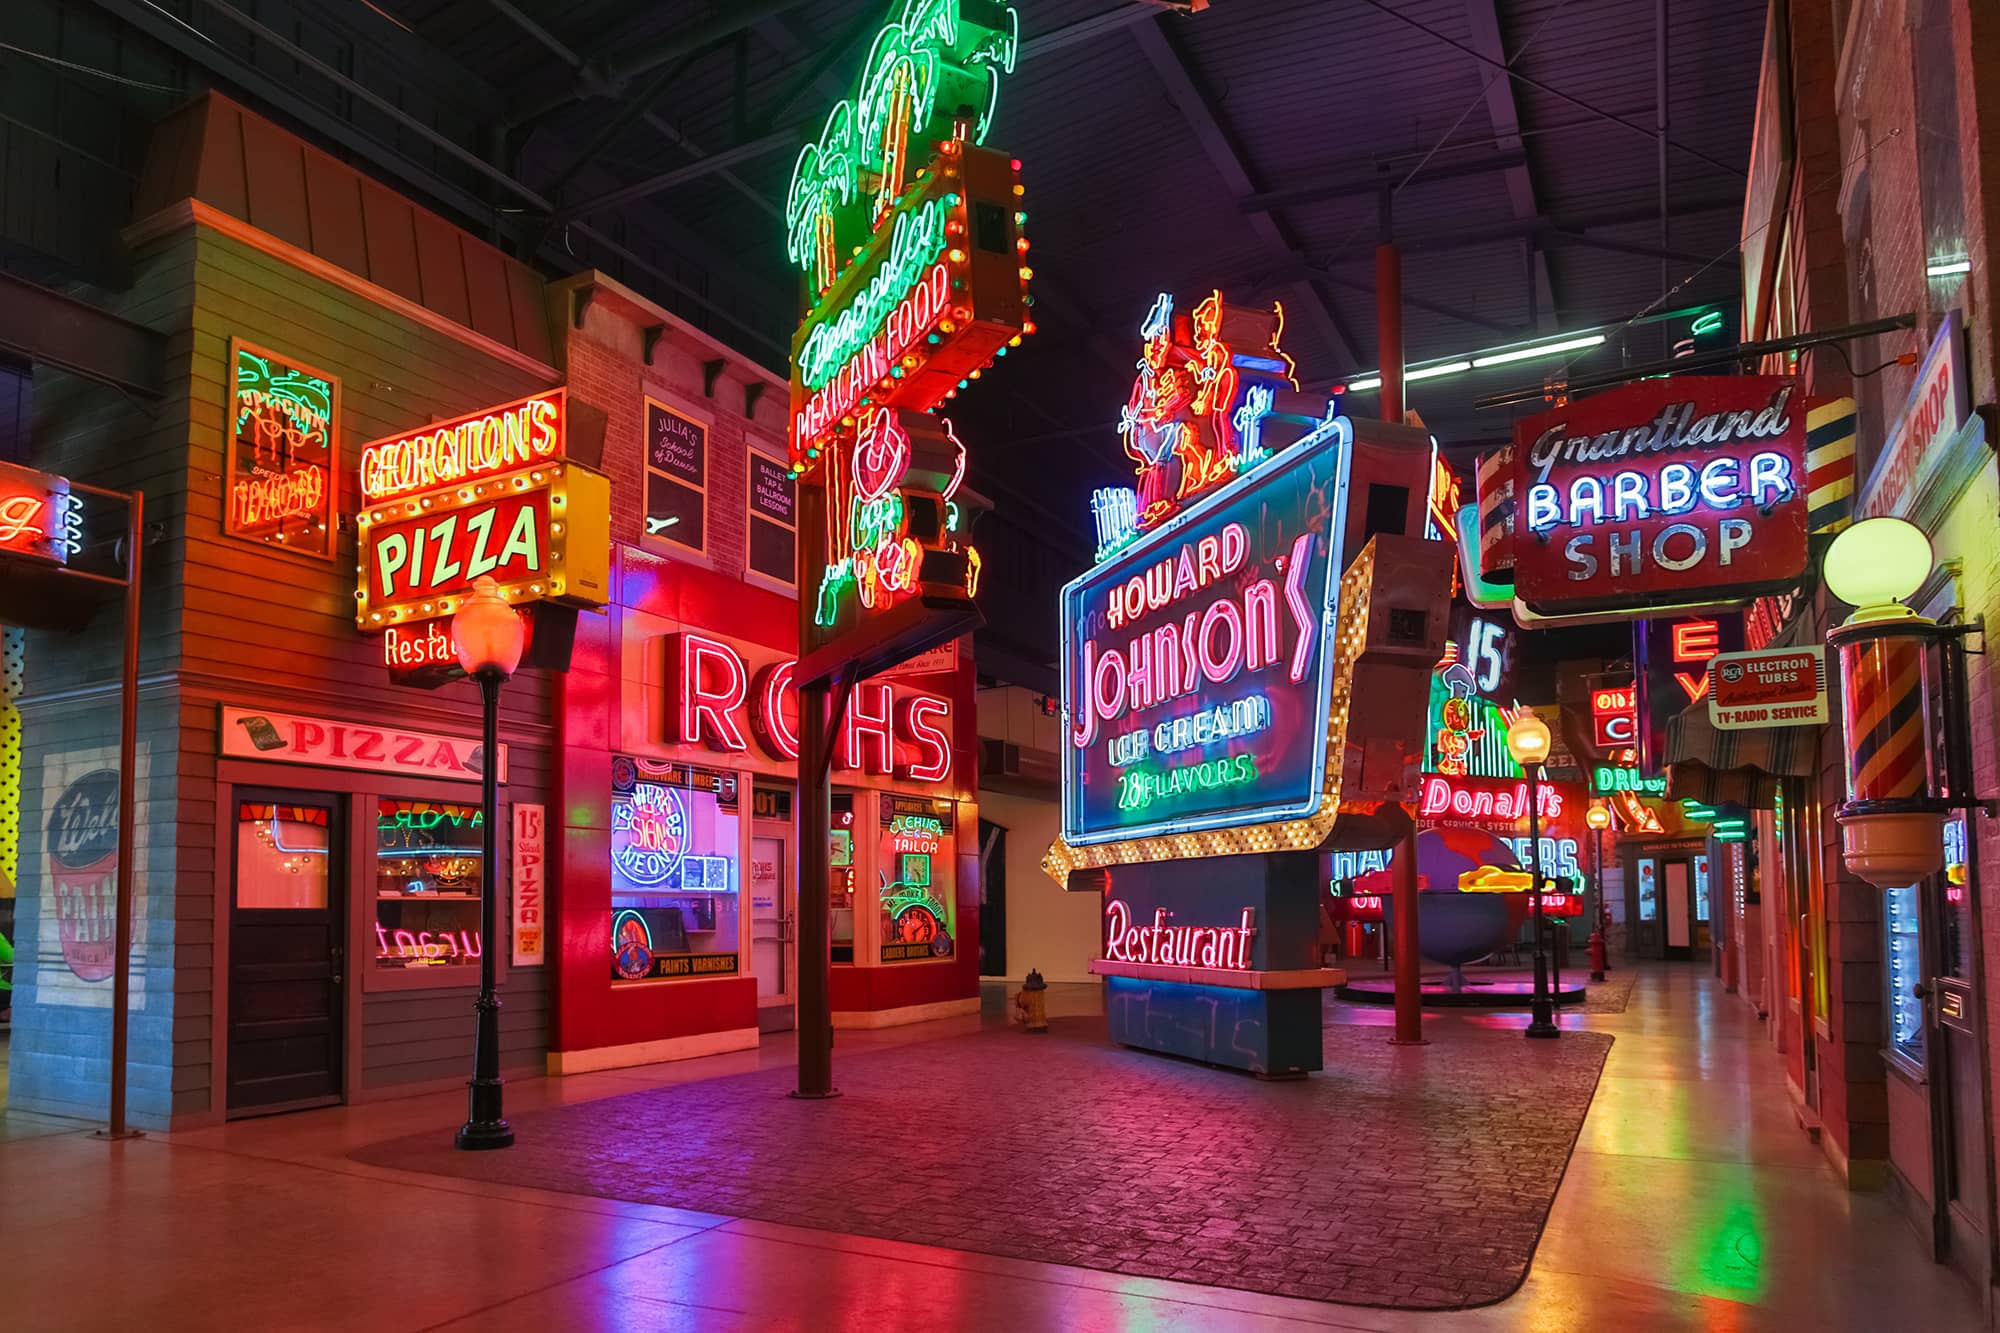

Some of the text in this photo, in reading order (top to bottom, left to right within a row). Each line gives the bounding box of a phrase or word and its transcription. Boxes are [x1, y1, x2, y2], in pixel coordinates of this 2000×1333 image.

[795, 264, 949, 450] MEXICAN FOOD
[658, 417, 698, 447] JULIA'S
[1913, 362, 1949, 466] SHOP
[659, 436, 695, 460] School
[759, 464, 786, 482] BALLET
[764, 476, 778, 488] TAP
[756, 484, 792, 507] BALLROOM
[759, 496, 789, 516] LESSONS
[1528, 451, 1796, 533] BARBER
[377, 505, 539, 597] PIZZA
[1565, 517, 1754, 581] SHOP
[1107, 522, 1251, 630] HOWARD
[385, 623, 459, 666] Resta
[1746, 658, 1809, 673] ELECTRON
[1758, 671, 1798, 684] TUBES
[1108, 695, 1272, 765] ICE CREAM
[1771, 705, 1818, 721] SERVICE
[289, 720, 466, 772] PIZZA
[1117, 754, 1259, 809] 28 FLAVORS
[621, 845, 672, 875] NEON
[894, 838, 939, 854] TAILOR
[519, 854, 541, 923] PIZZA
[1105, 899, 1257, 969] Restaurant
[660, 958, 690, 976] PAINTS
